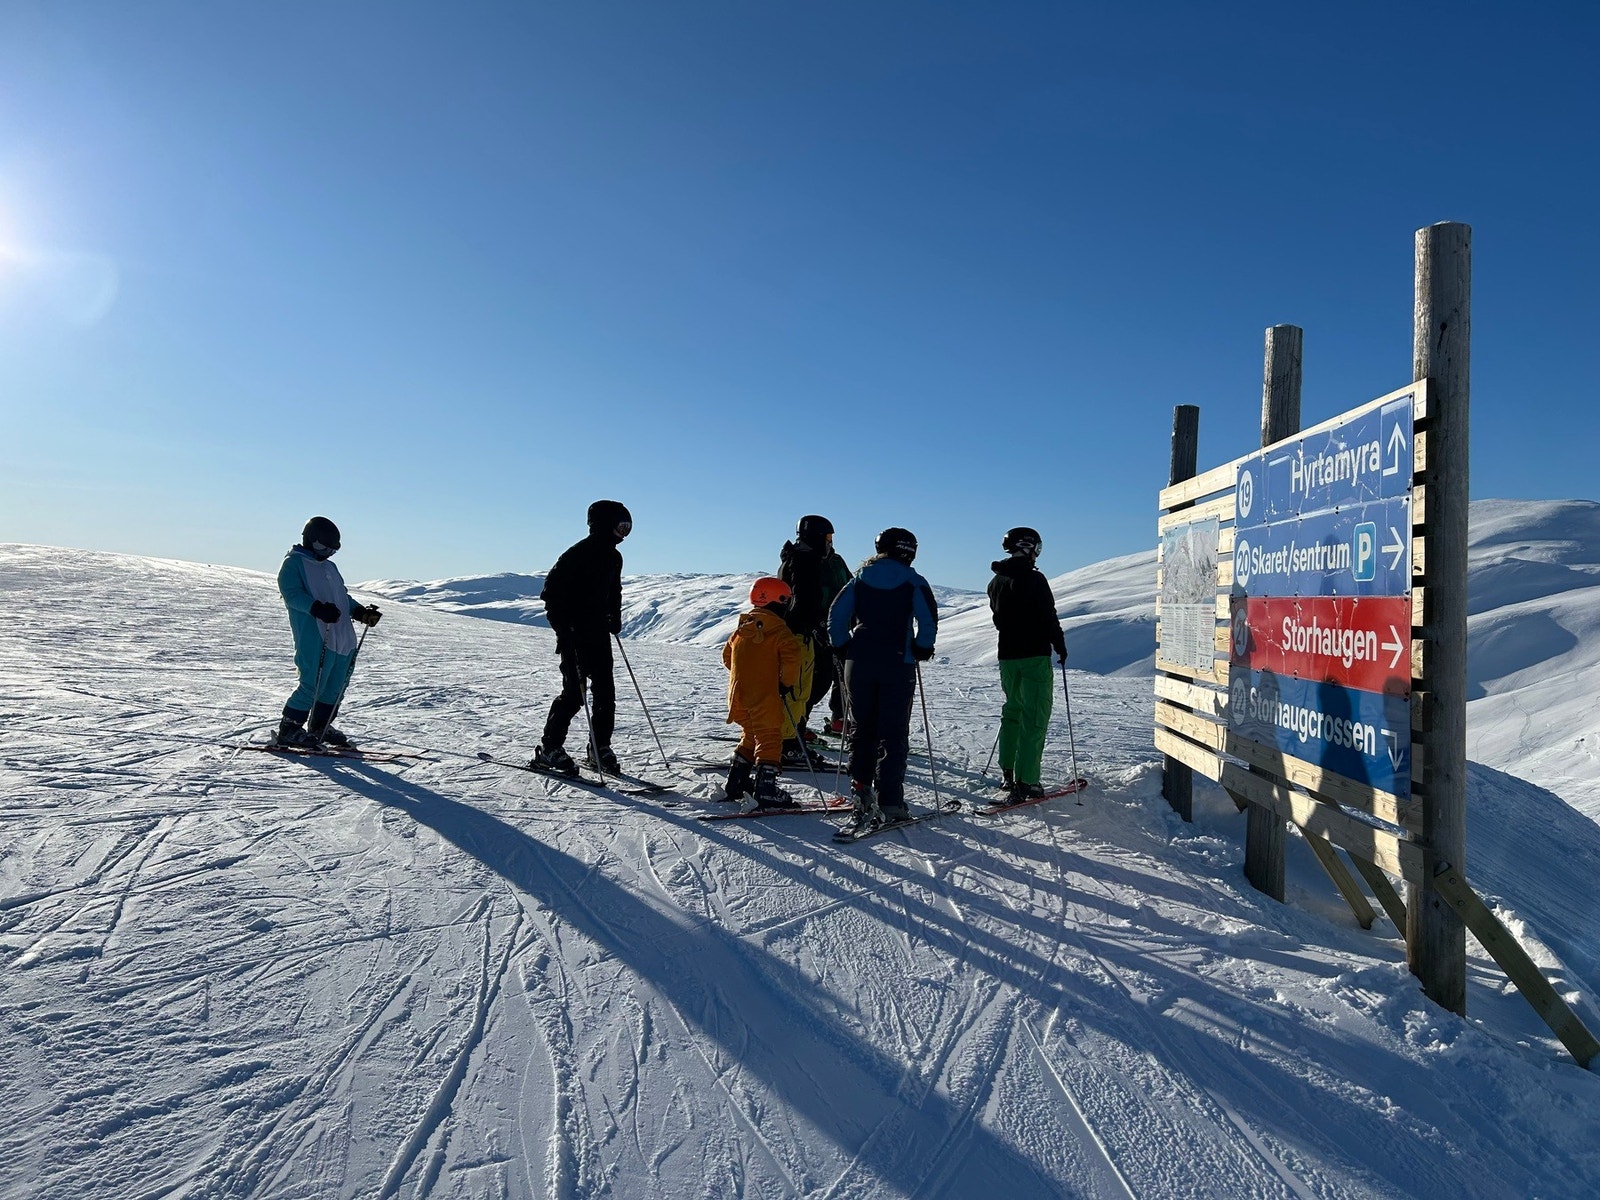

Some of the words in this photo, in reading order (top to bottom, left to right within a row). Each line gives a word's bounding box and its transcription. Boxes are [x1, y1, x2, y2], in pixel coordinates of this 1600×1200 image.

[1292, 440, 1380, 499] Hyrtamyra
[1241, 481, 1250, 507] 19
[1238, 550, 1249, 576] 20
[1251, 541, 1350, 576] Skaret/sentrum
[1359, 532, 1371, 572] P
[1235, 621, 1245, 645] 21
[1283, 616, 1377, 669] Storhaugen
[1233, 688, 1244, 715] 22
[1250, 687, 1375, 756] Storhaugcrossen
